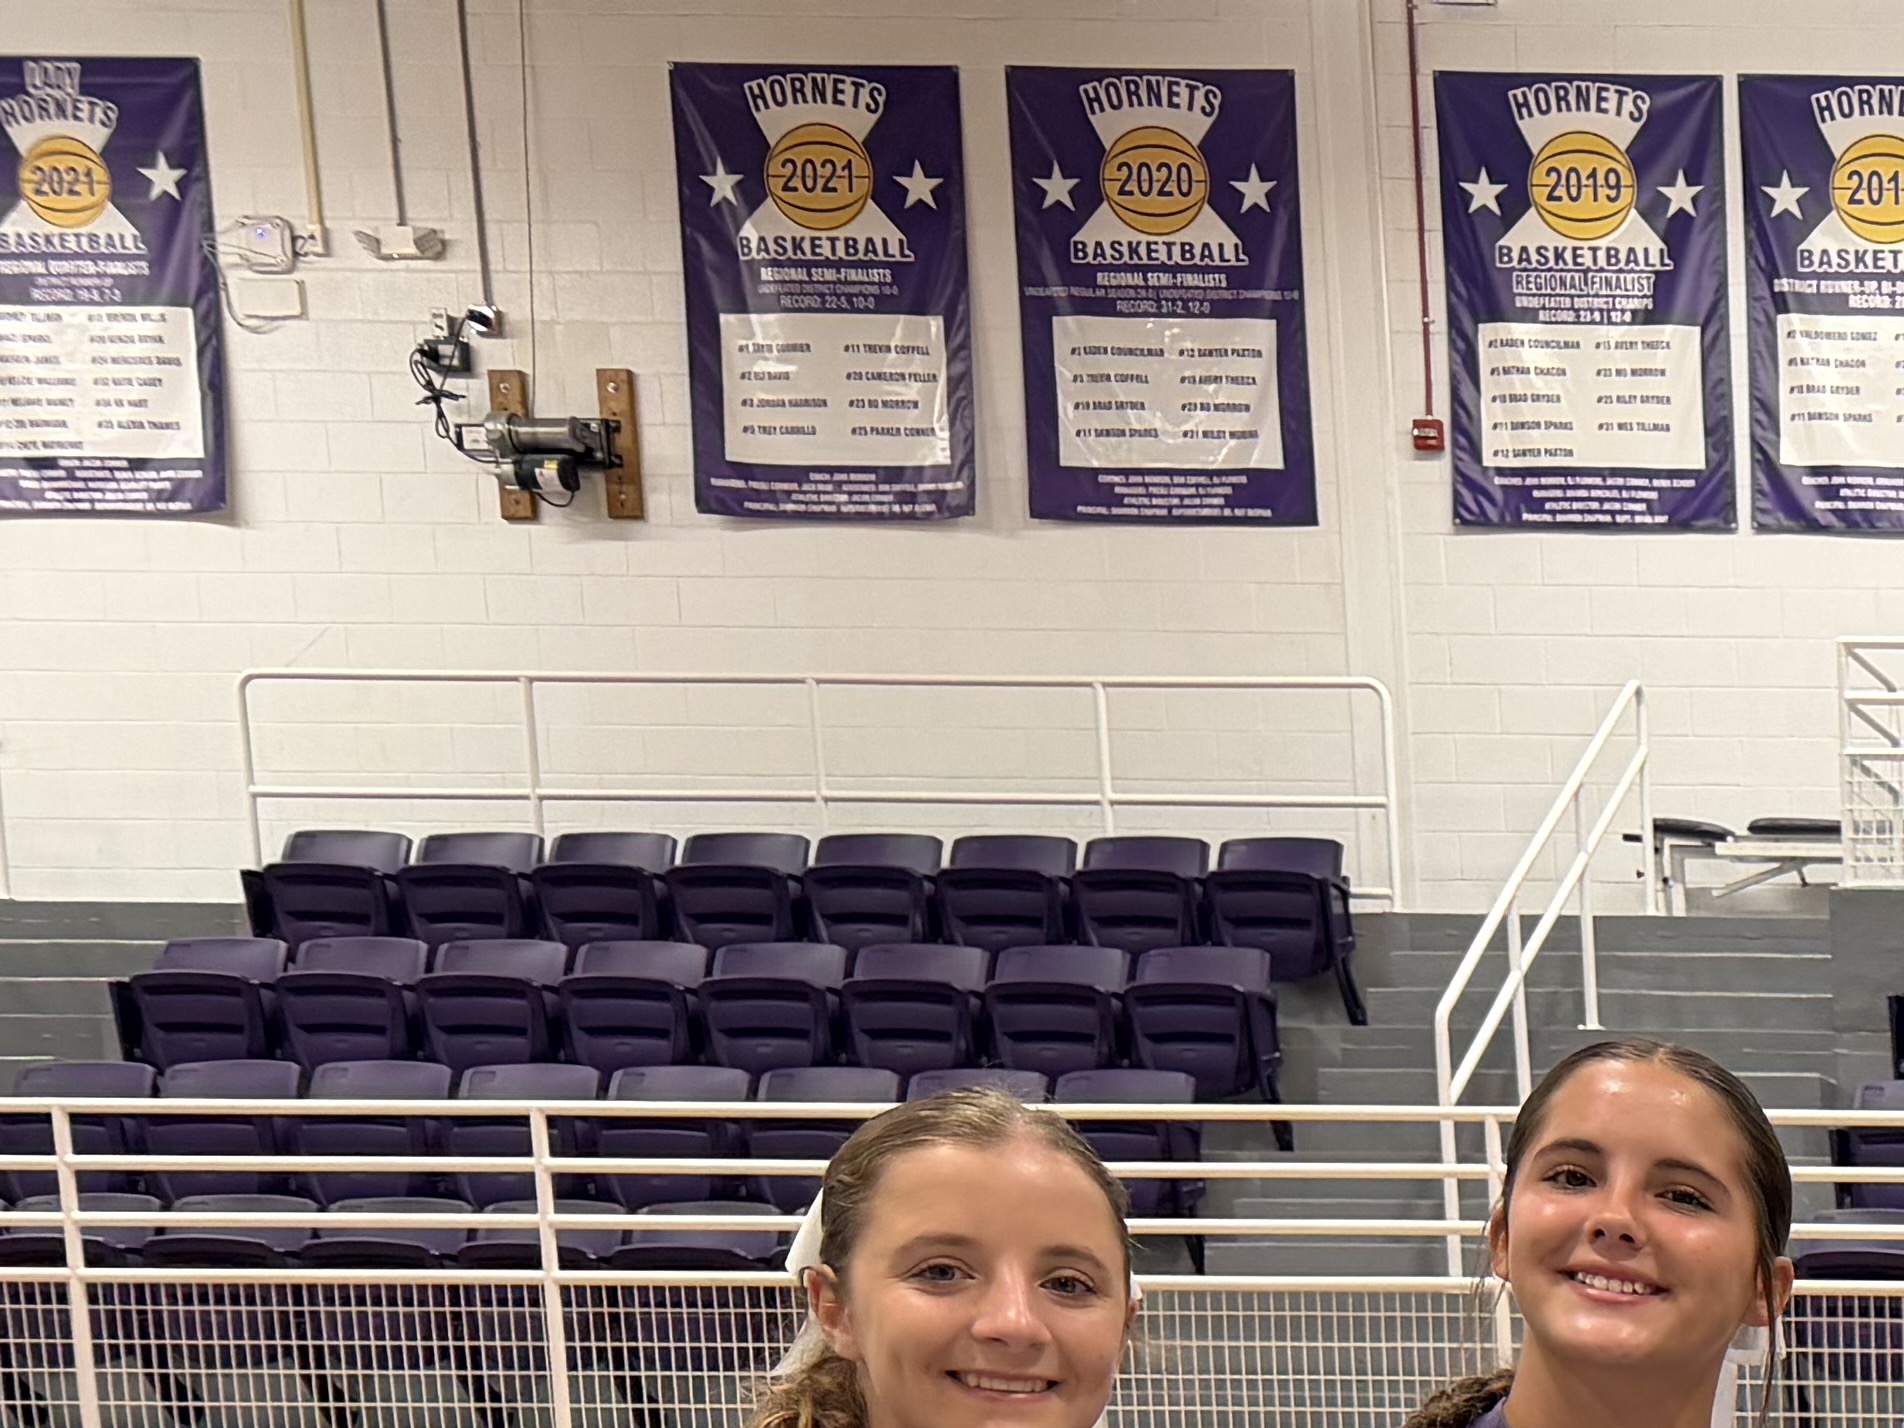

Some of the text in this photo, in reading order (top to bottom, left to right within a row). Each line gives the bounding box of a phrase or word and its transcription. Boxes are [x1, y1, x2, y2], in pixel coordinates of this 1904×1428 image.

[746, 74, 884, 115] HORNETS
[1082, 78, 1219, 117] HORNETS
[1511, 83, 1648, 122] HORNETS
[1, 96, 117, 129] HORNETS
[31, 165, 96, 197] 2021
[780, 158, 854, 193] 2021
[1116, 161, 1193, 198] 2020
[1545, 166, 1622, 203] 2019
[739, 235, 914, 259] BASKETBALL
[1072, 240, 1247, 263] BASKETBALL
[1498, 244, 1673, 268] BASKETBALL
[761, 267, 892, 283] REGIONAL SEMI-FINALISTS
[1515, 273, 1655, 294] REGIONAL FINALIST
